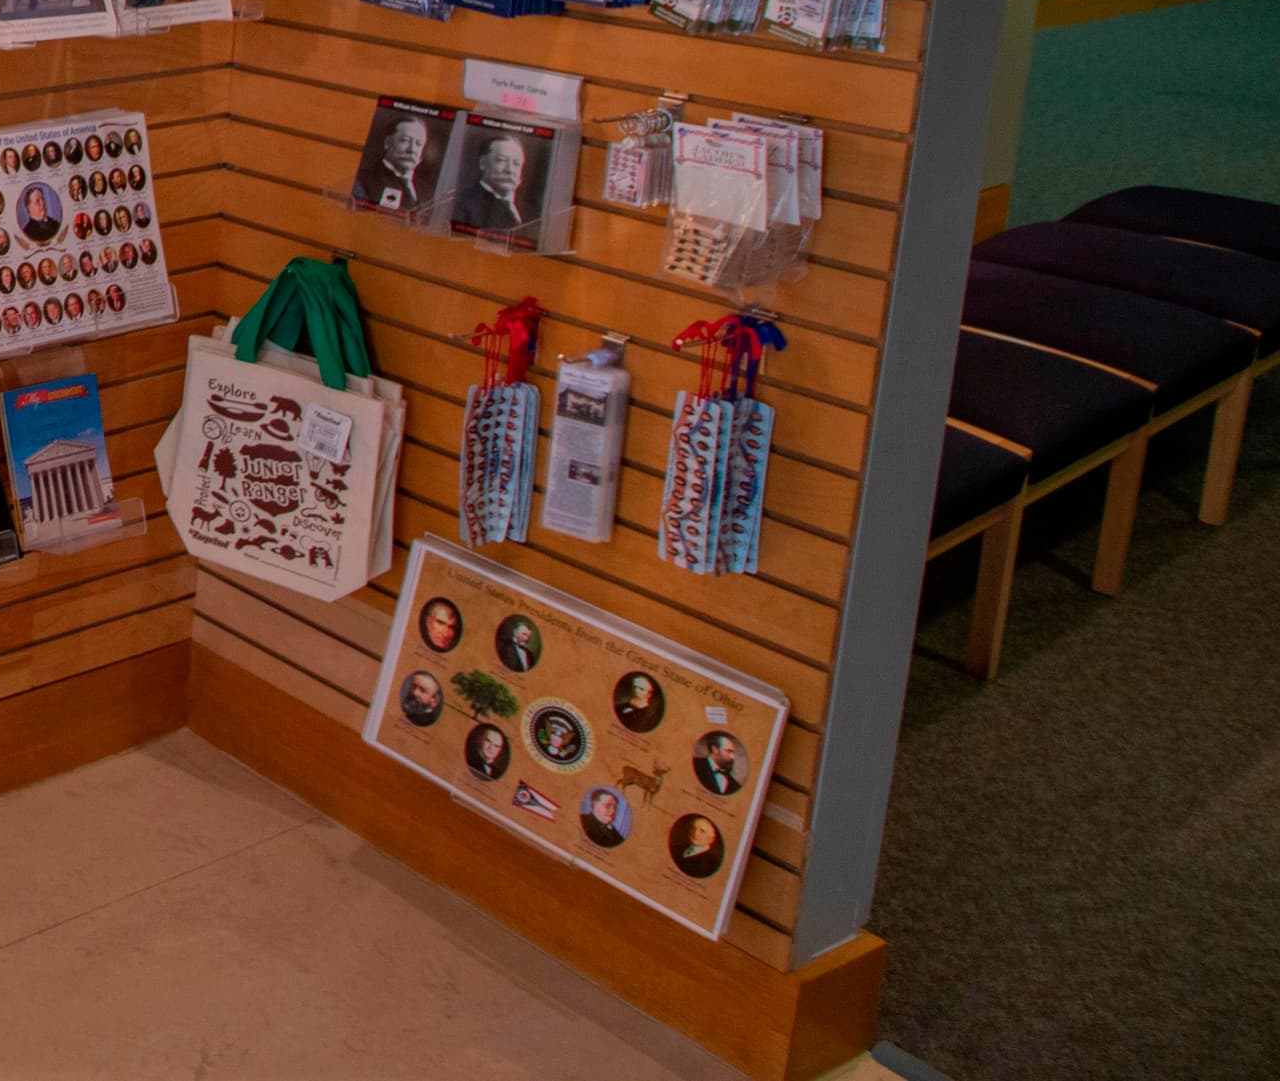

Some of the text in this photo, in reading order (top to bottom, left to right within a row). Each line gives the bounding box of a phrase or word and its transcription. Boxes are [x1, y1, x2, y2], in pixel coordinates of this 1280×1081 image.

[4, 137, 14, 145] the
[16, 133, 38, 143] United
[40, 129, 61, 139] States
[63, 128, 69, 136] of
[70, 124, 96, 135] America
[208, 379, 257, 400] Explore
[194, 475, 211, 506] Protect
[293, 516, 343, 541] Discover
[710, 691, 745, 712] Ohio
